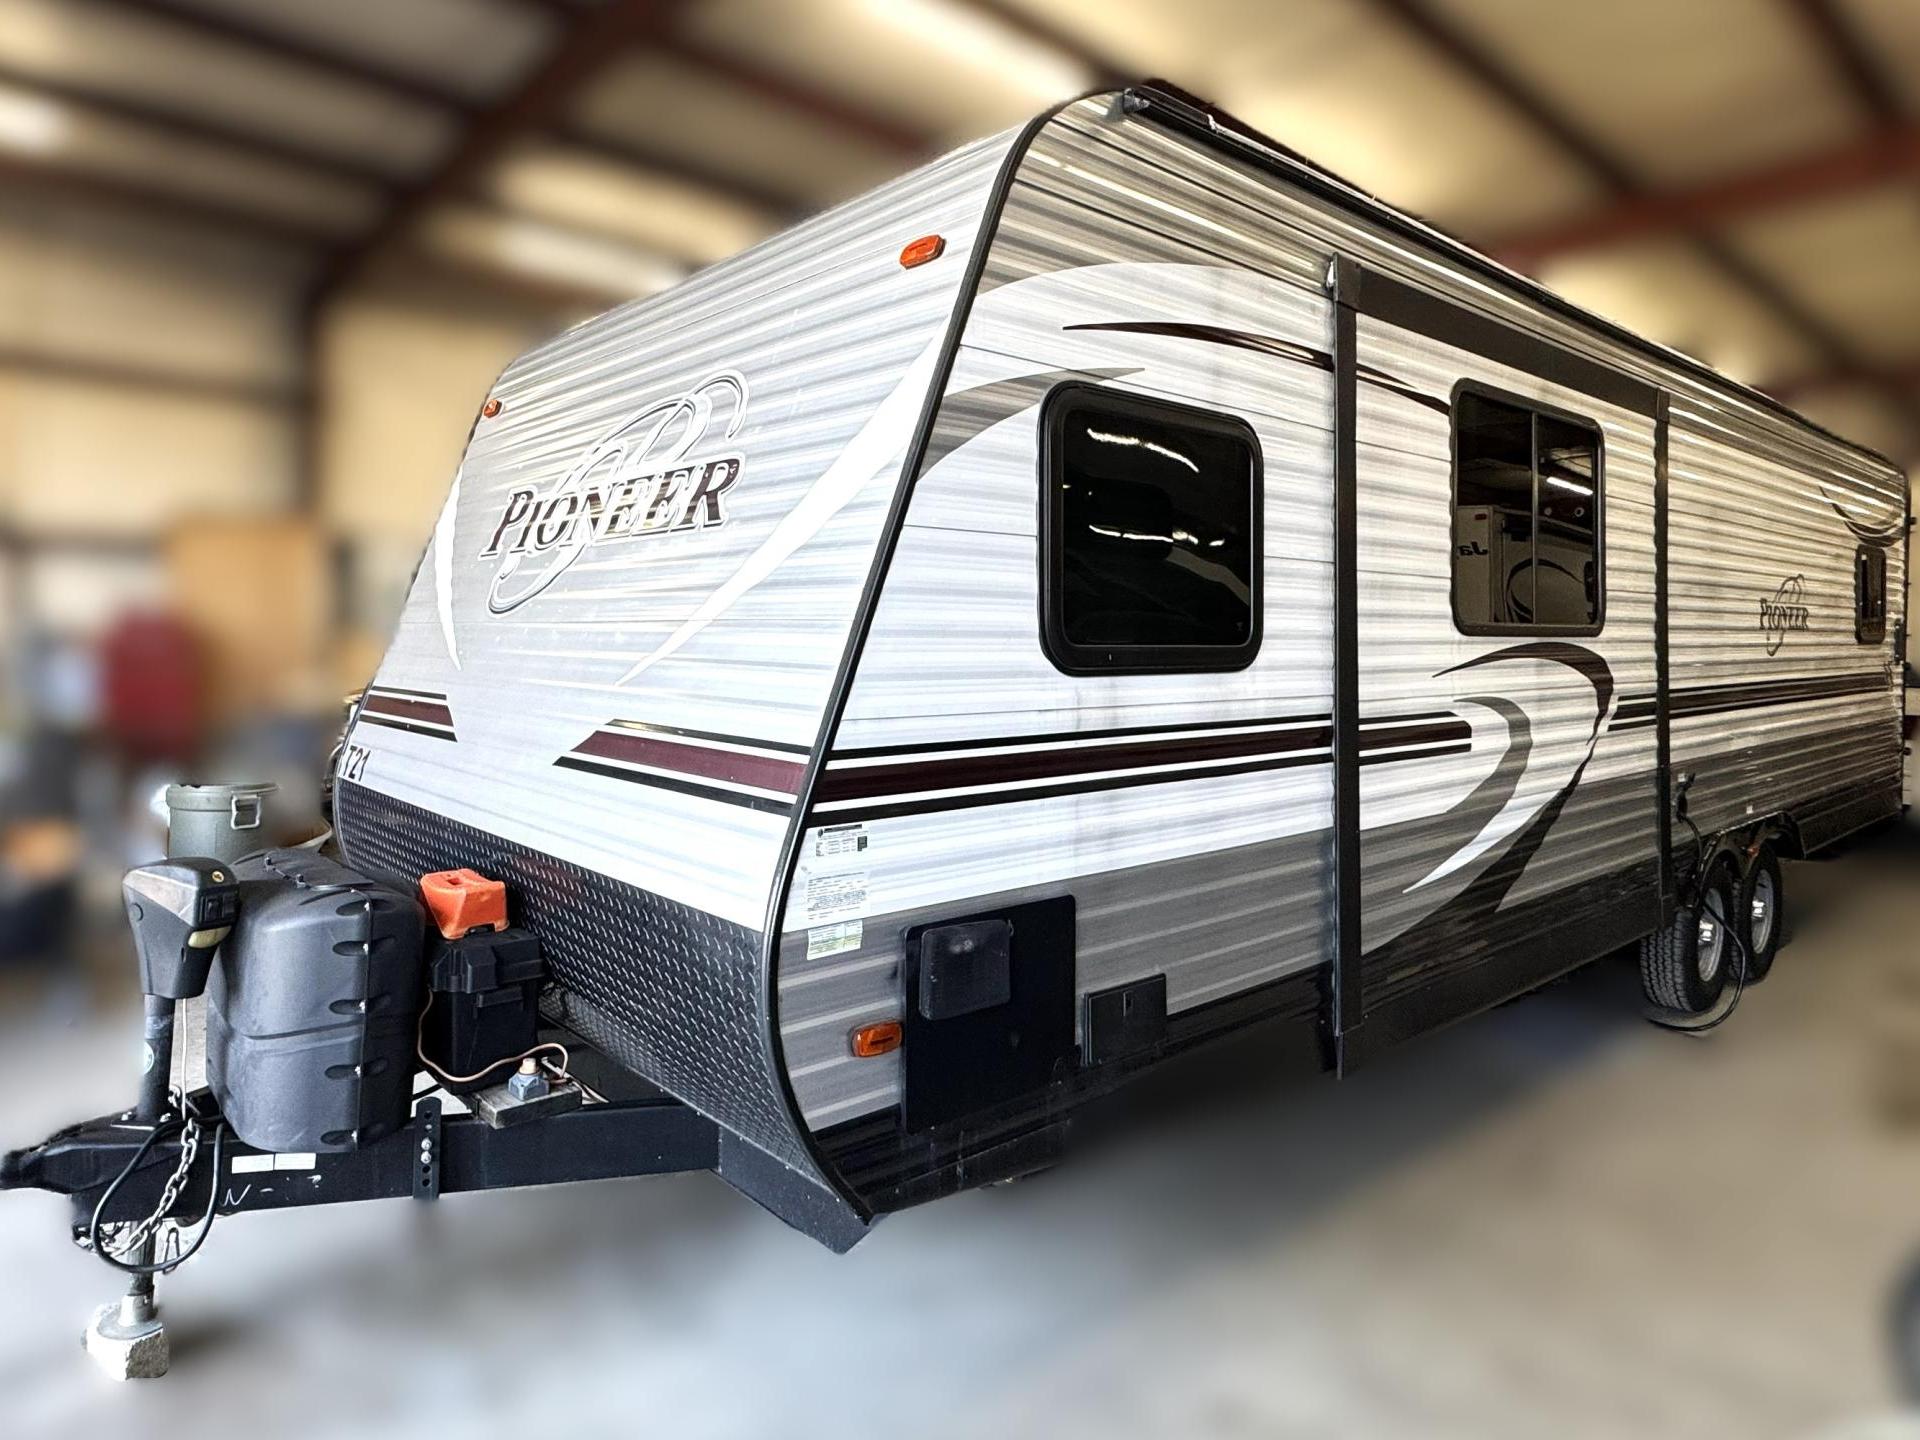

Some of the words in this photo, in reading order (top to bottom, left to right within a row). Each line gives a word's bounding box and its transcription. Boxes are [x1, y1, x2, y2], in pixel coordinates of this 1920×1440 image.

[480, 458, 741, 557] PIONEER
[1759, 598, 1809, 631] PIONEER
[343, 745, 371, 782] T21
